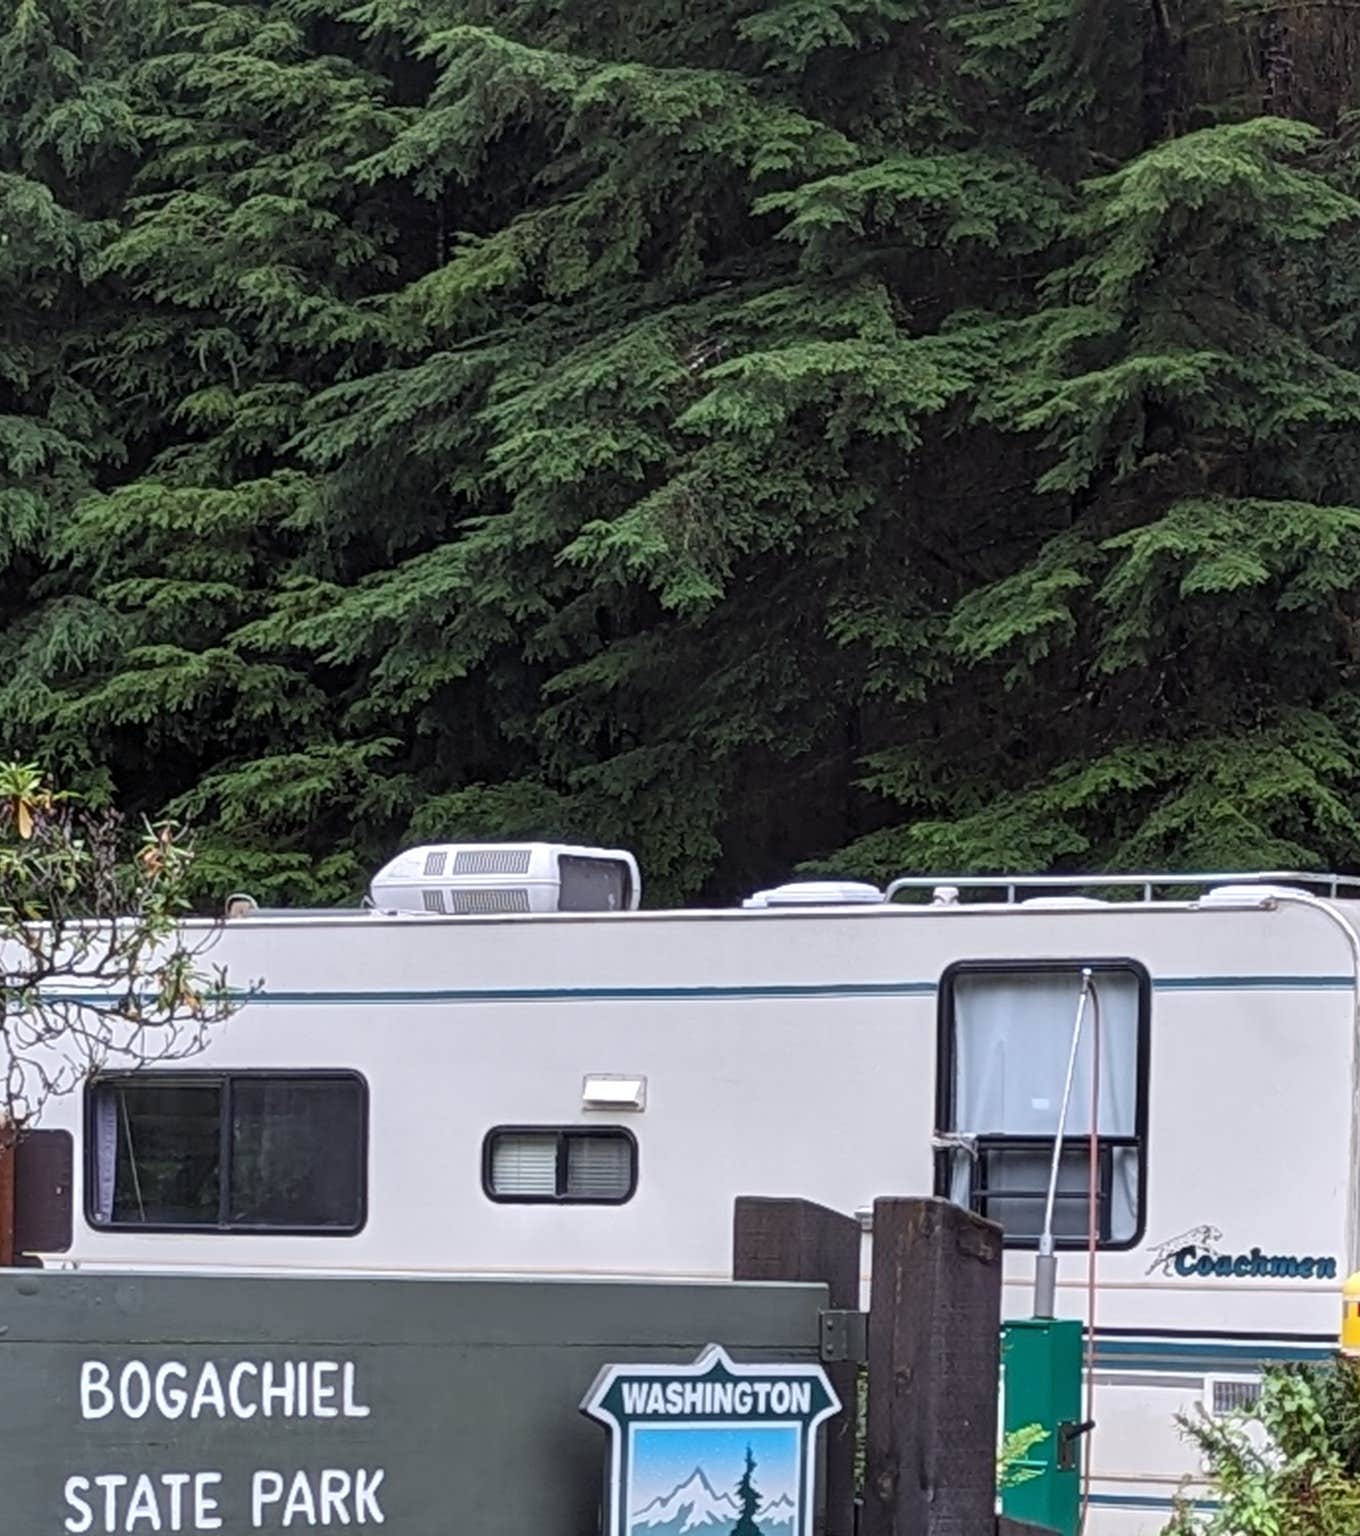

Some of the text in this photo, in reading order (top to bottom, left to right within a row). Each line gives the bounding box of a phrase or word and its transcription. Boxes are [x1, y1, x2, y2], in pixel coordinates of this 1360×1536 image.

[1174, 1246, 1337, 1279] Coachmen
[80, 1360, 371, 1419] BOGACHIEL
[621, 1382, 812, 1415] WASHINGTON
[64, 1469, 385, 1533] STATE PARK
